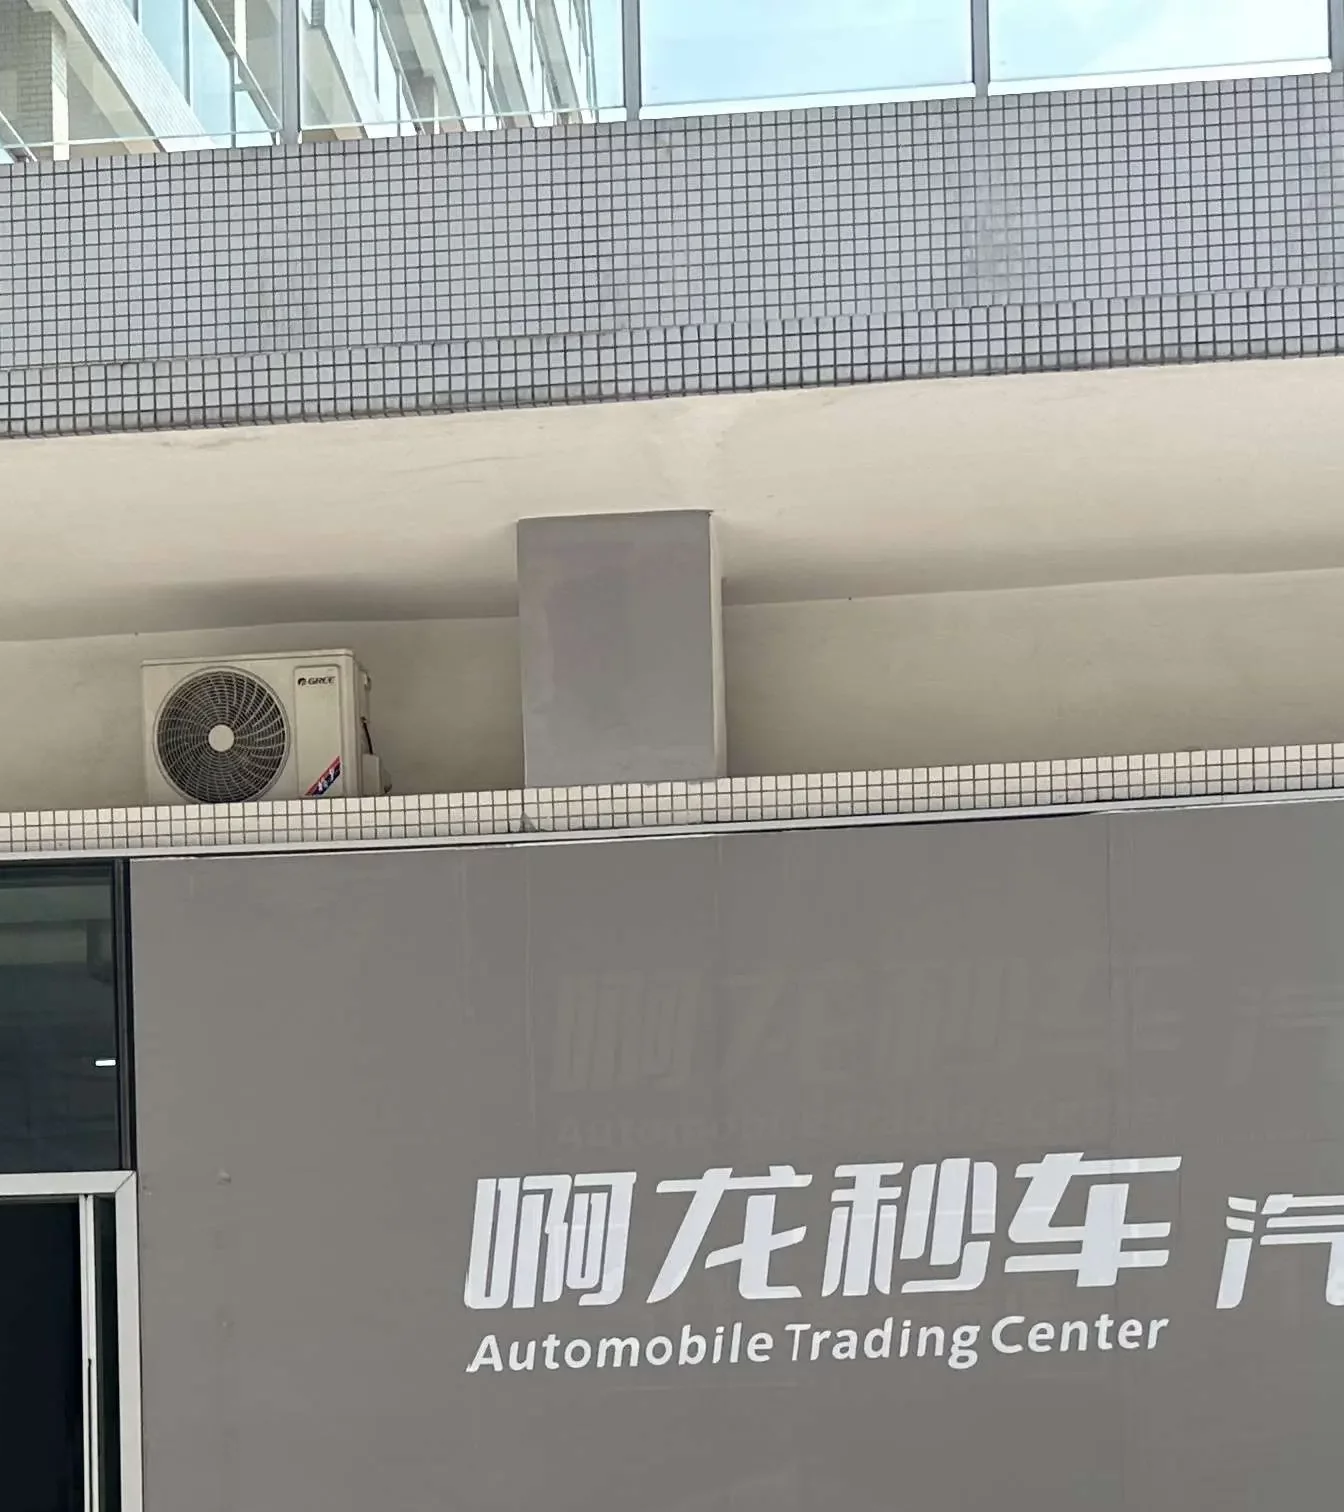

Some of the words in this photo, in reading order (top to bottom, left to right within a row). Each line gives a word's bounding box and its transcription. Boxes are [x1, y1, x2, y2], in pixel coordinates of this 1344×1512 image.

[462, 1151, 1183, 1311] 啊龙秒车
[464, 1322, 774, 1374] Automobile
[784, 1315, 982, 1371] Trading
[990, 1312, 1170, 1355] Center
